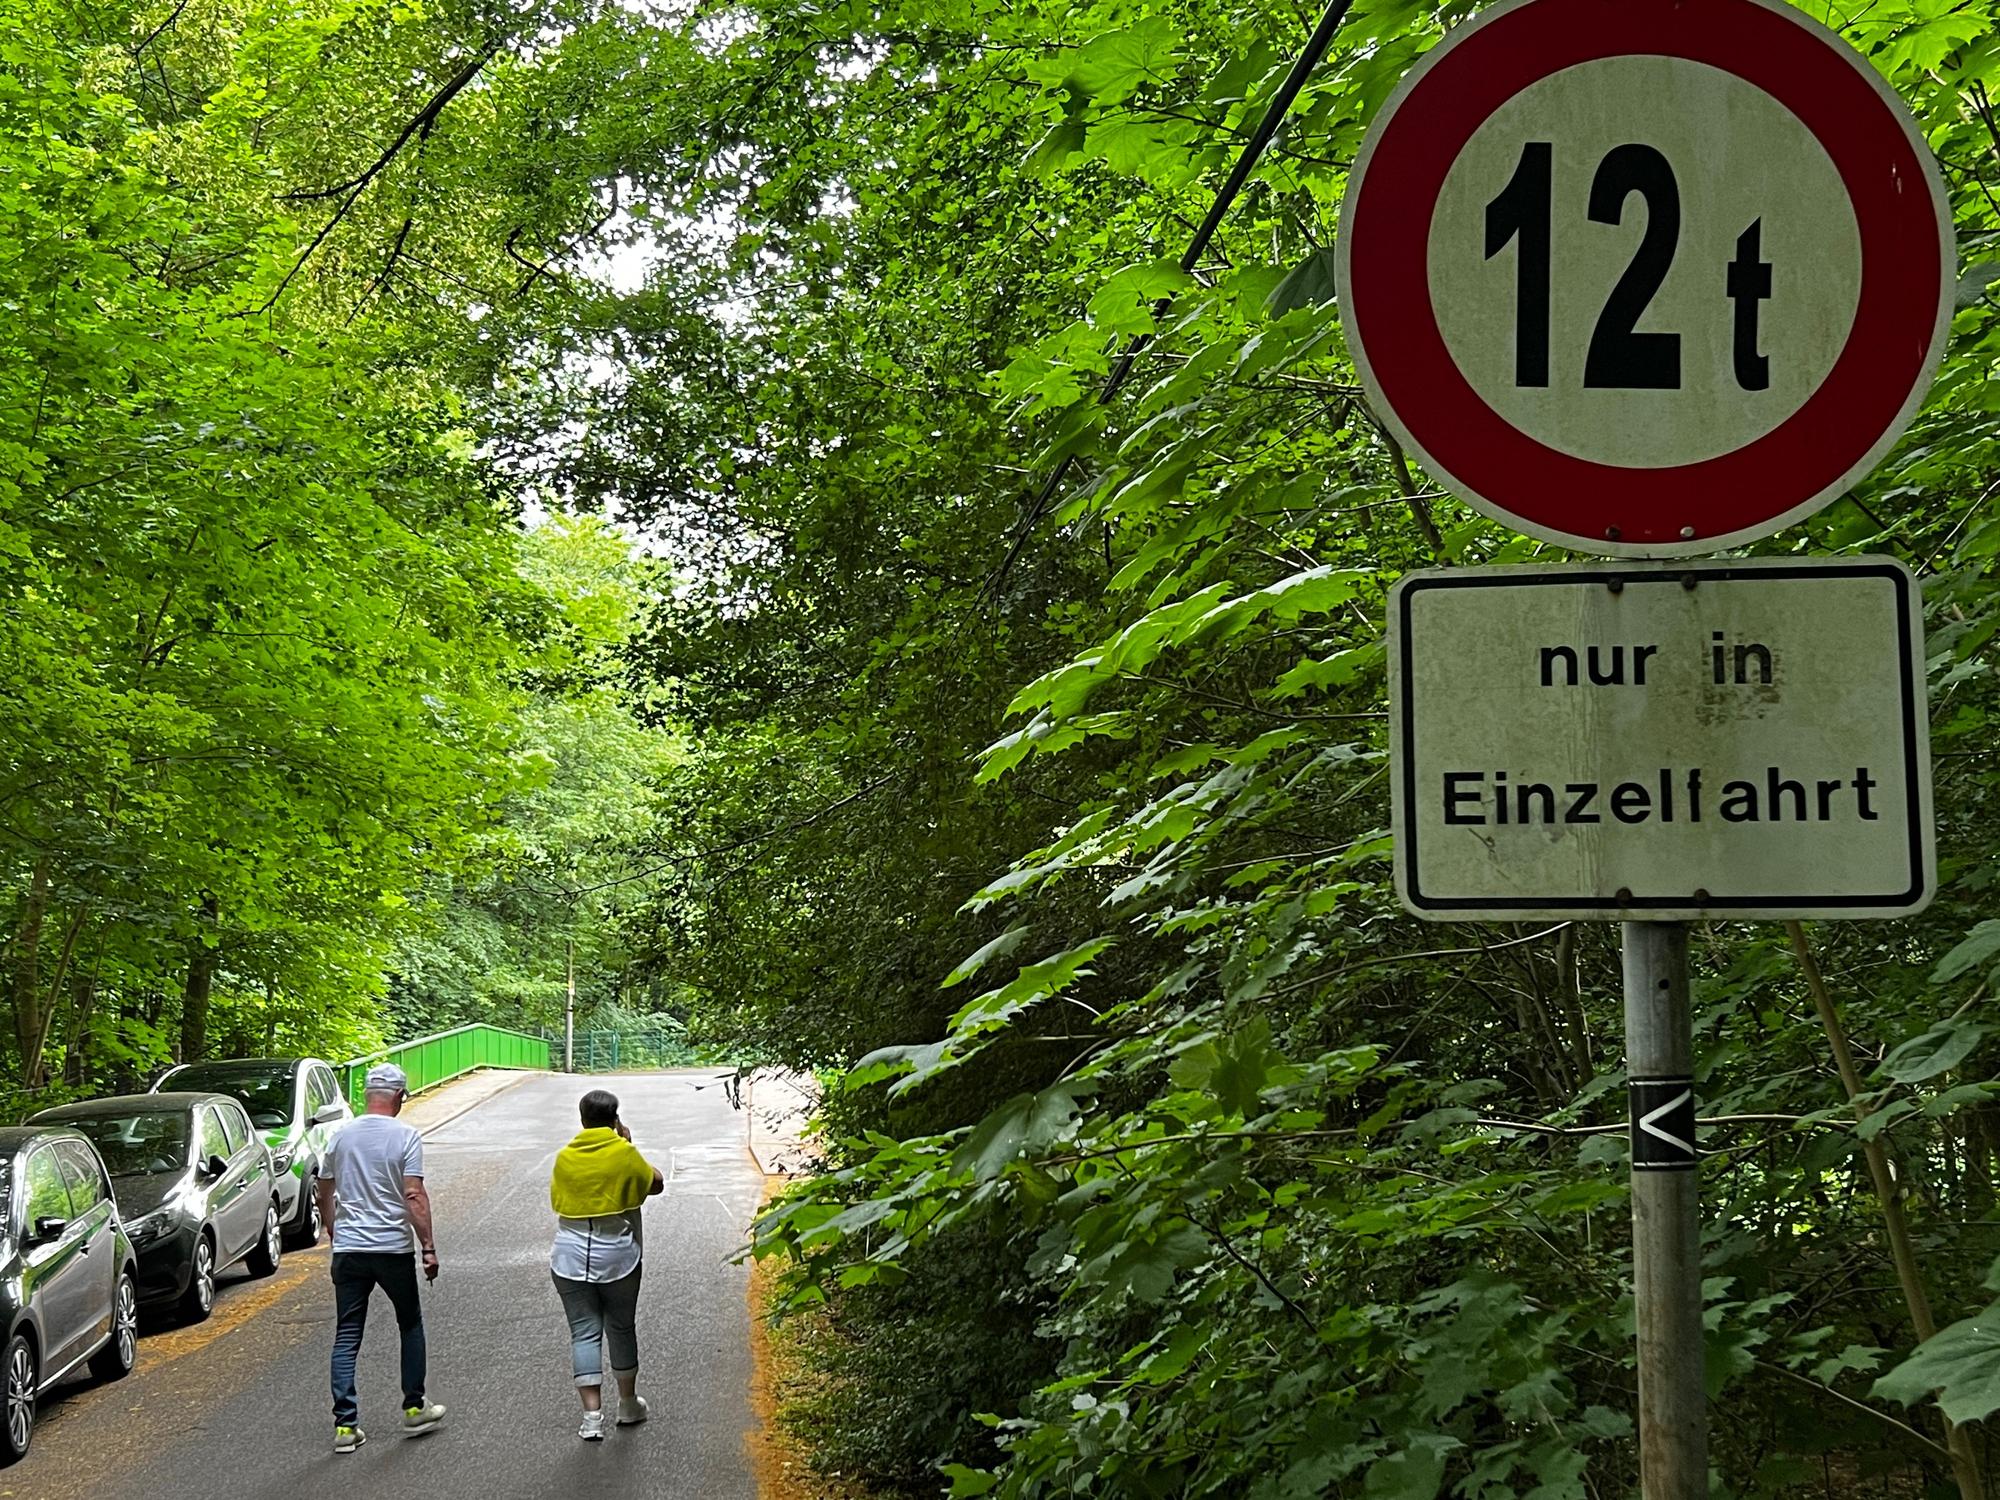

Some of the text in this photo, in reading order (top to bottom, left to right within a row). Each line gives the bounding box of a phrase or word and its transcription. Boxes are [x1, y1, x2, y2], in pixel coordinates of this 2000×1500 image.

[1485, 142, 1772, 391] 12 t
[1540, 631, 1773, 687] nur in
[1443, 767, 1879, 825] Einzelfahrt
